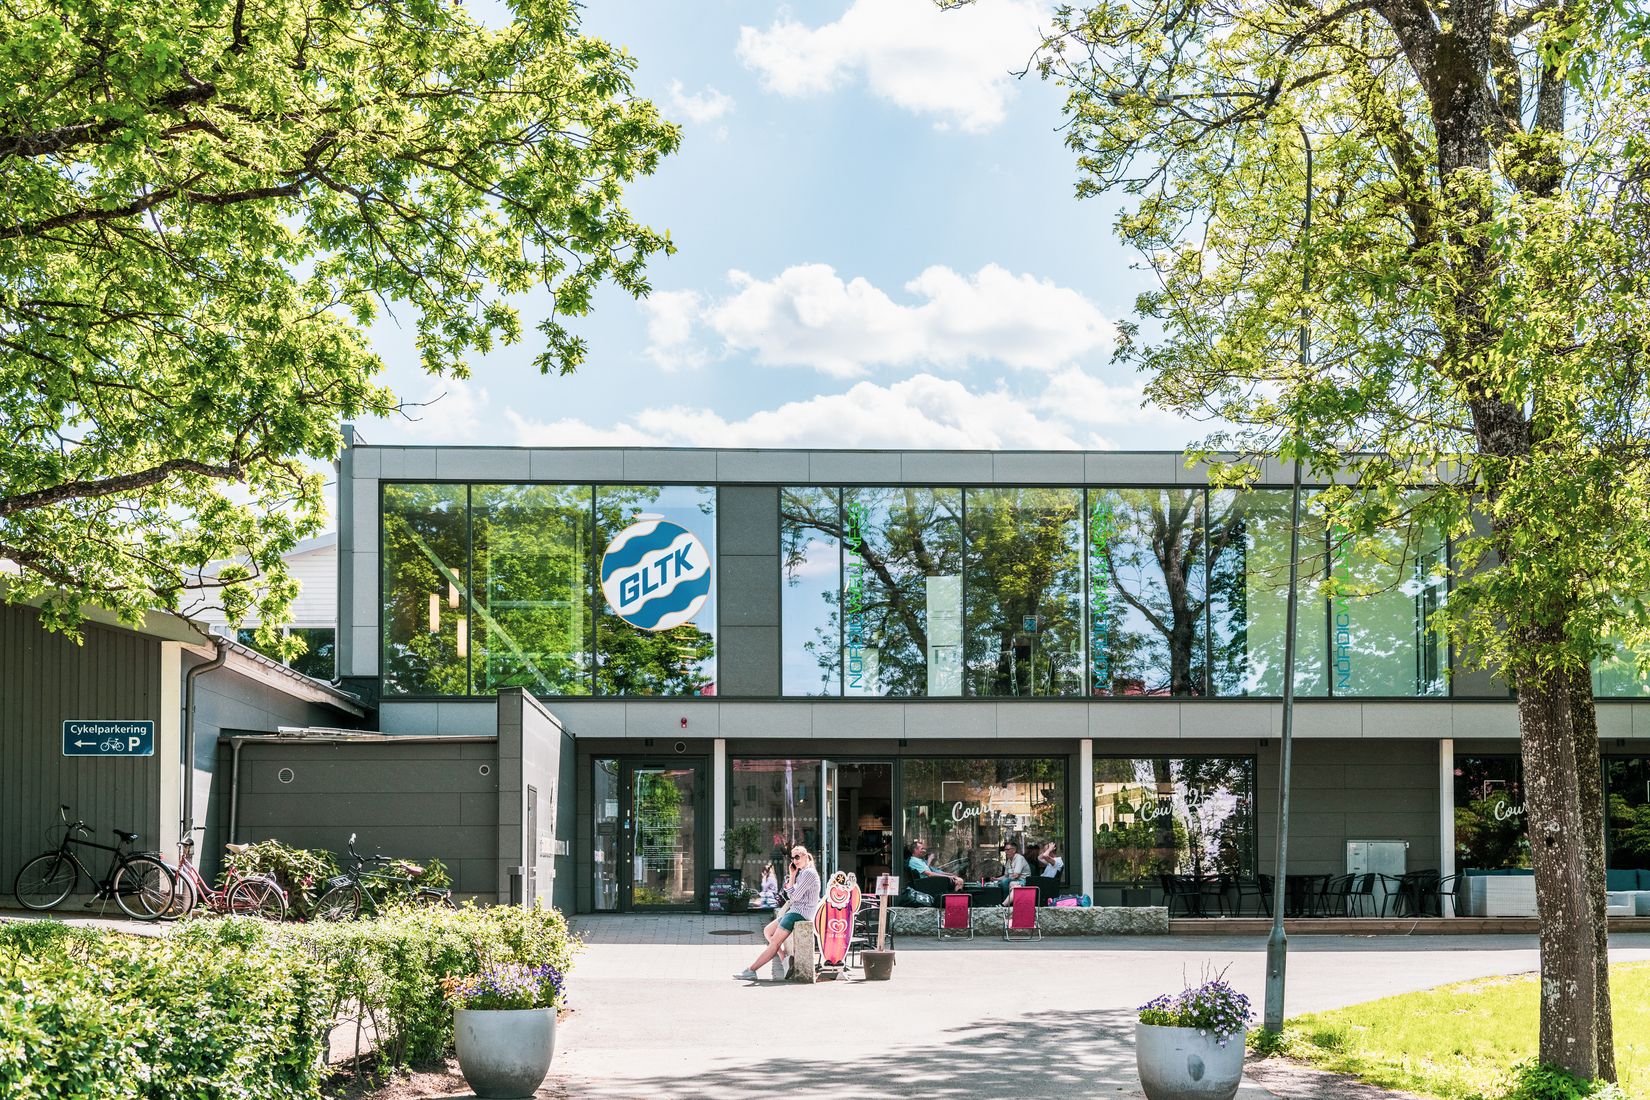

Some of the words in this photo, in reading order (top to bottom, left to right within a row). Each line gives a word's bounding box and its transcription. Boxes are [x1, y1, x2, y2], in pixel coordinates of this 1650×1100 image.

[620, 542, 694, 608] GLTK
[70, 724, 147, 736] Cykelparkering
[128, 736, 141, 752] P
